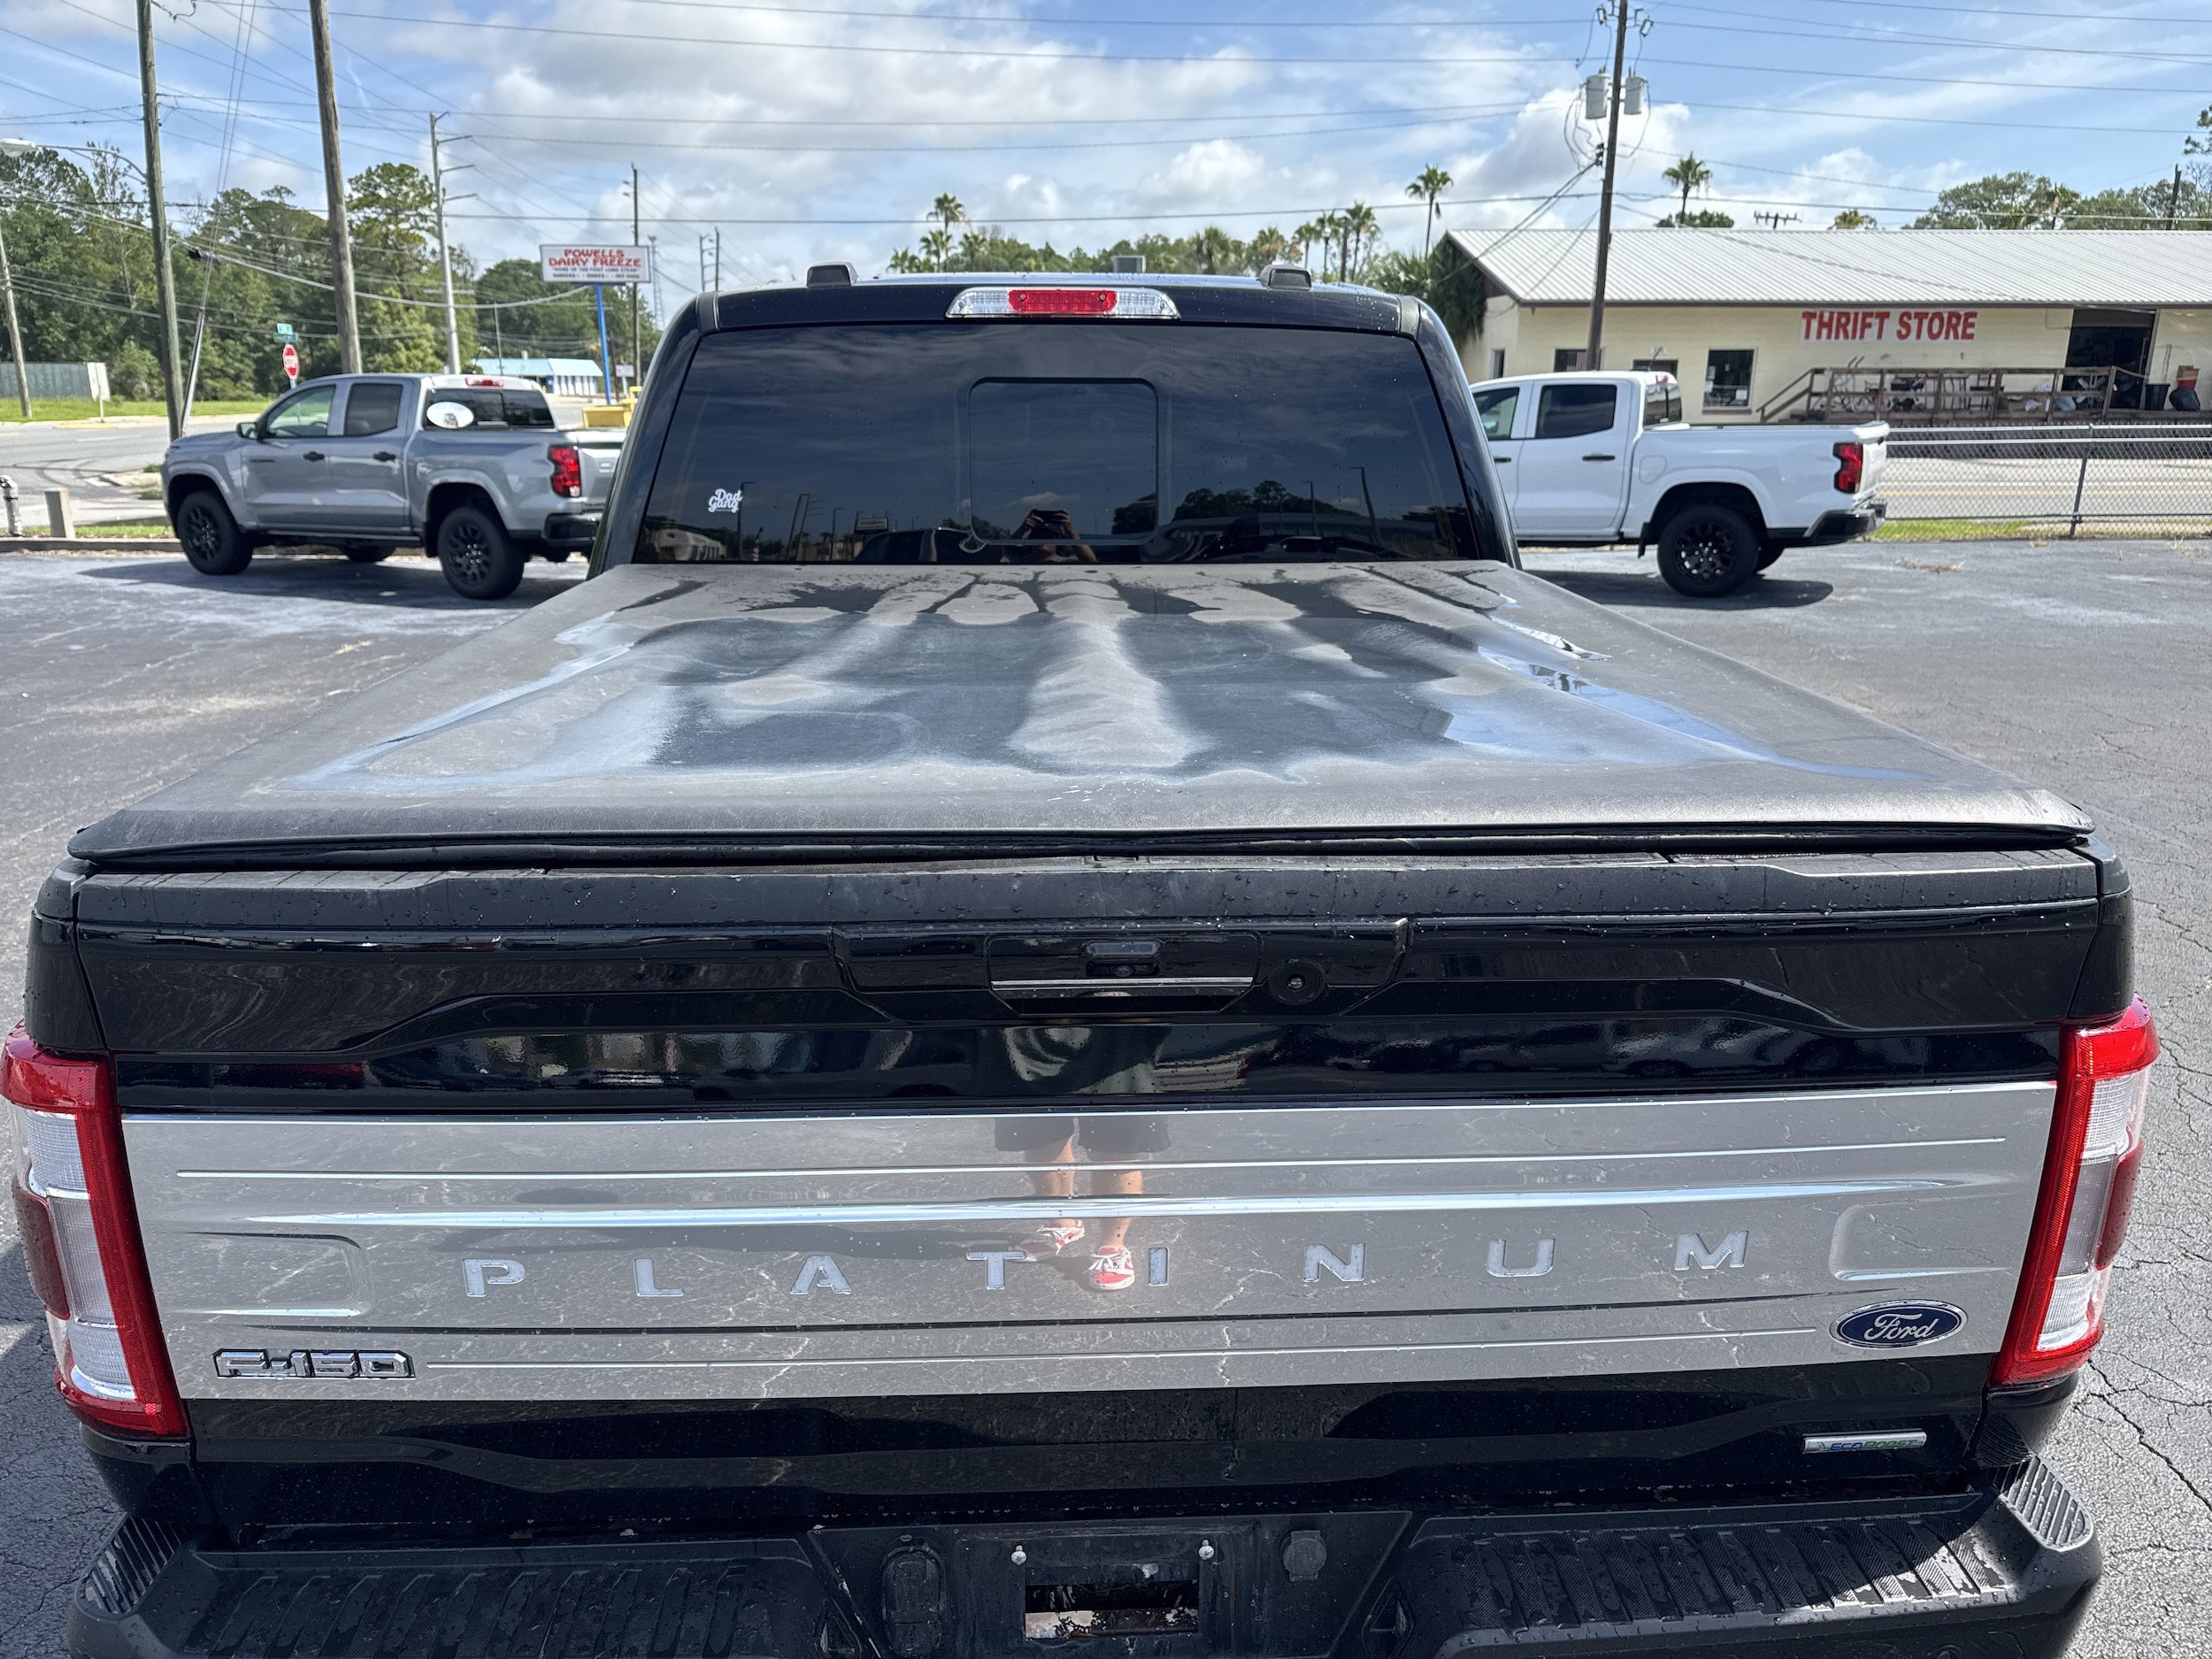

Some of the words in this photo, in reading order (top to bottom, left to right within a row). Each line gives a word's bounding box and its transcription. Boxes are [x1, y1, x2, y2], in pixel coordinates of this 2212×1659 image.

[549, 257, 588, 266] DAIRY
[592, 257, 641, 267] FREEZE
[564, 249, 625, 257] POWELLS
[1801, 311, 1891, 341] THRIFT
[1896, 311, 1978, 341] STORE
[708, 495, 739, 513] Gang
[715, 488, 742, 502] Dad
[461, 1231, 1749, 1297] PLATINUM
[1863, 1313, 1939, 1340] Ford
[213, 1348, 416, 1379] F-150
